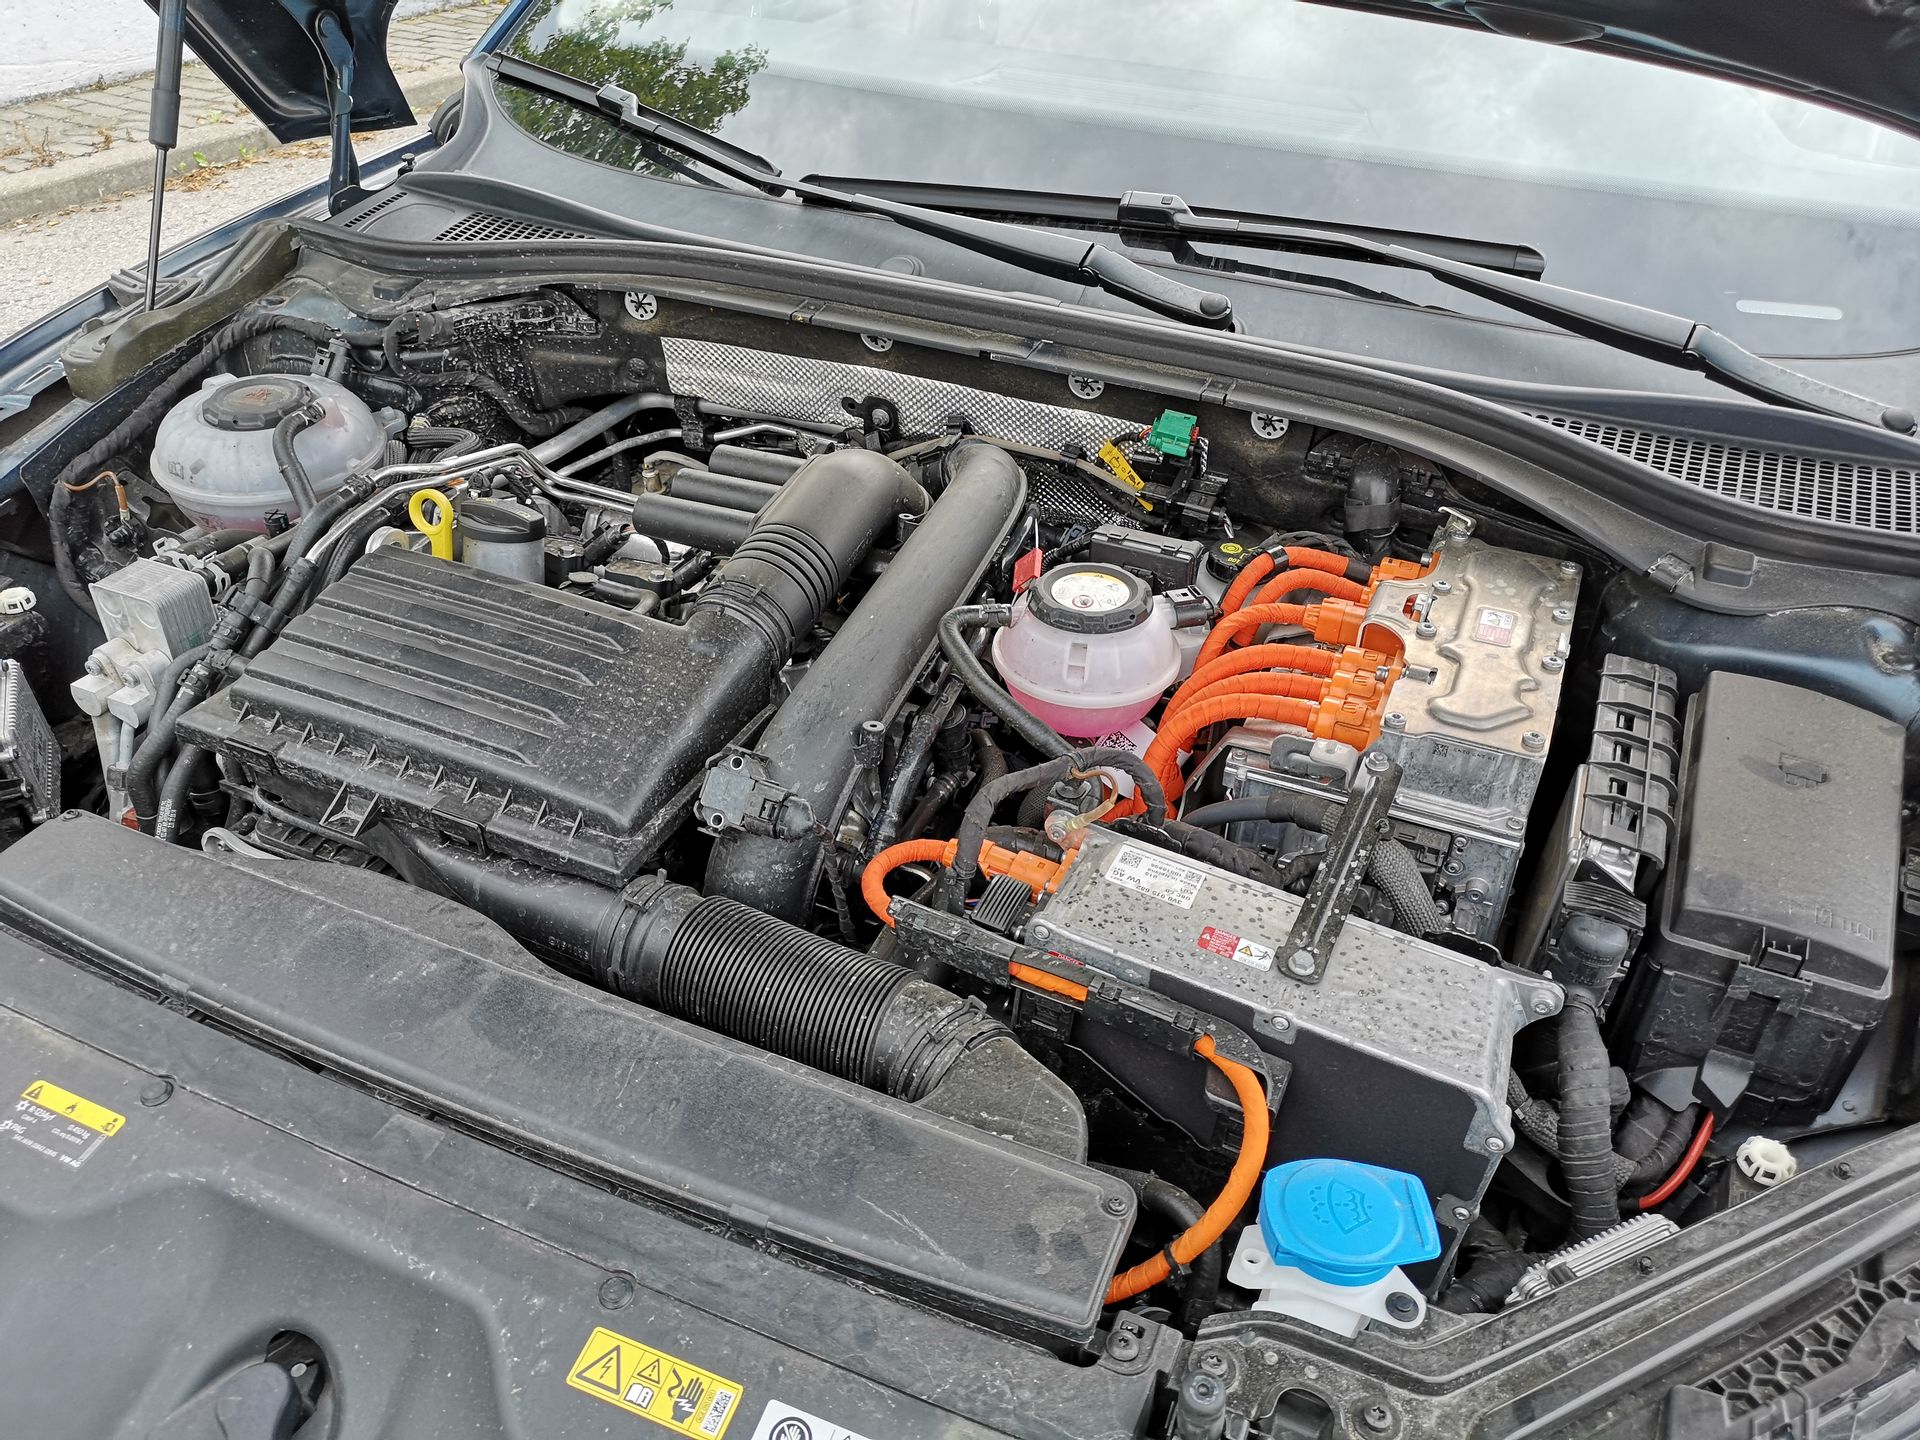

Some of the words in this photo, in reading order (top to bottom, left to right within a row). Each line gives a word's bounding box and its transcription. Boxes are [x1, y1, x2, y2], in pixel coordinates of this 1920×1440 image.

[1112, 869, 1125, 878] AG
[1126, 875, 1141, 884] VW
[1167, 896, 1183, 905] 3V0
